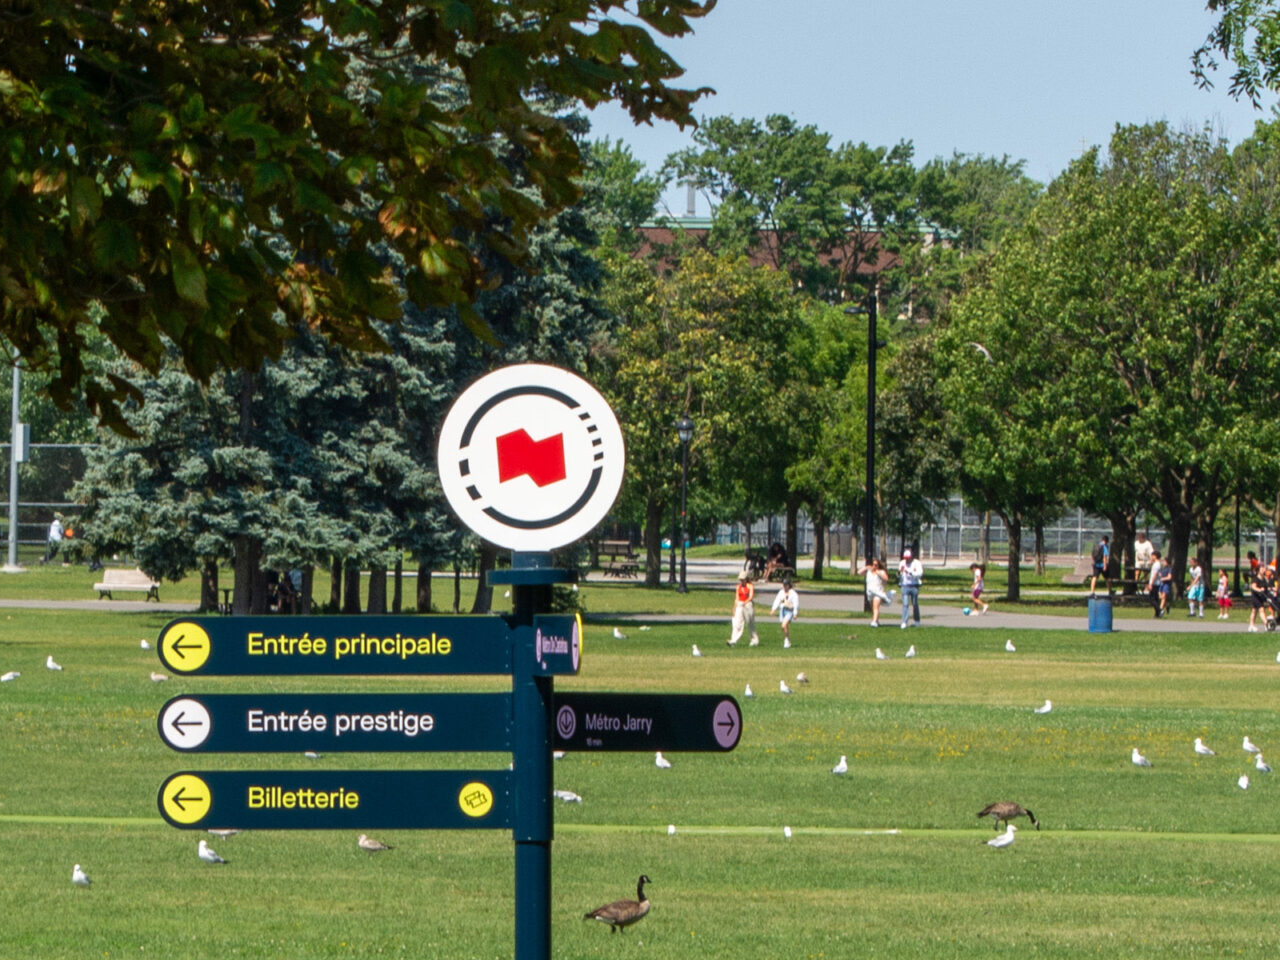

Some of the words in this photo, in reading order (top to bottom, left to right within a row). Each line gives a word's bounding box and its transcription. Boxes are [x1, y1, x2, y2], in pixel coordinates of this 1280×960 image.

[247, 632, 327, 656] Entrée
[335, 632, 452, 660] principale
[247, 709, 327, 733] Entrée
[335, 709, 434, 737] prestige
[585, 713, 620, 732] Métro
[623, 714, 653, 736] Jarry
[248, 786, 360, 809] Billetterie
